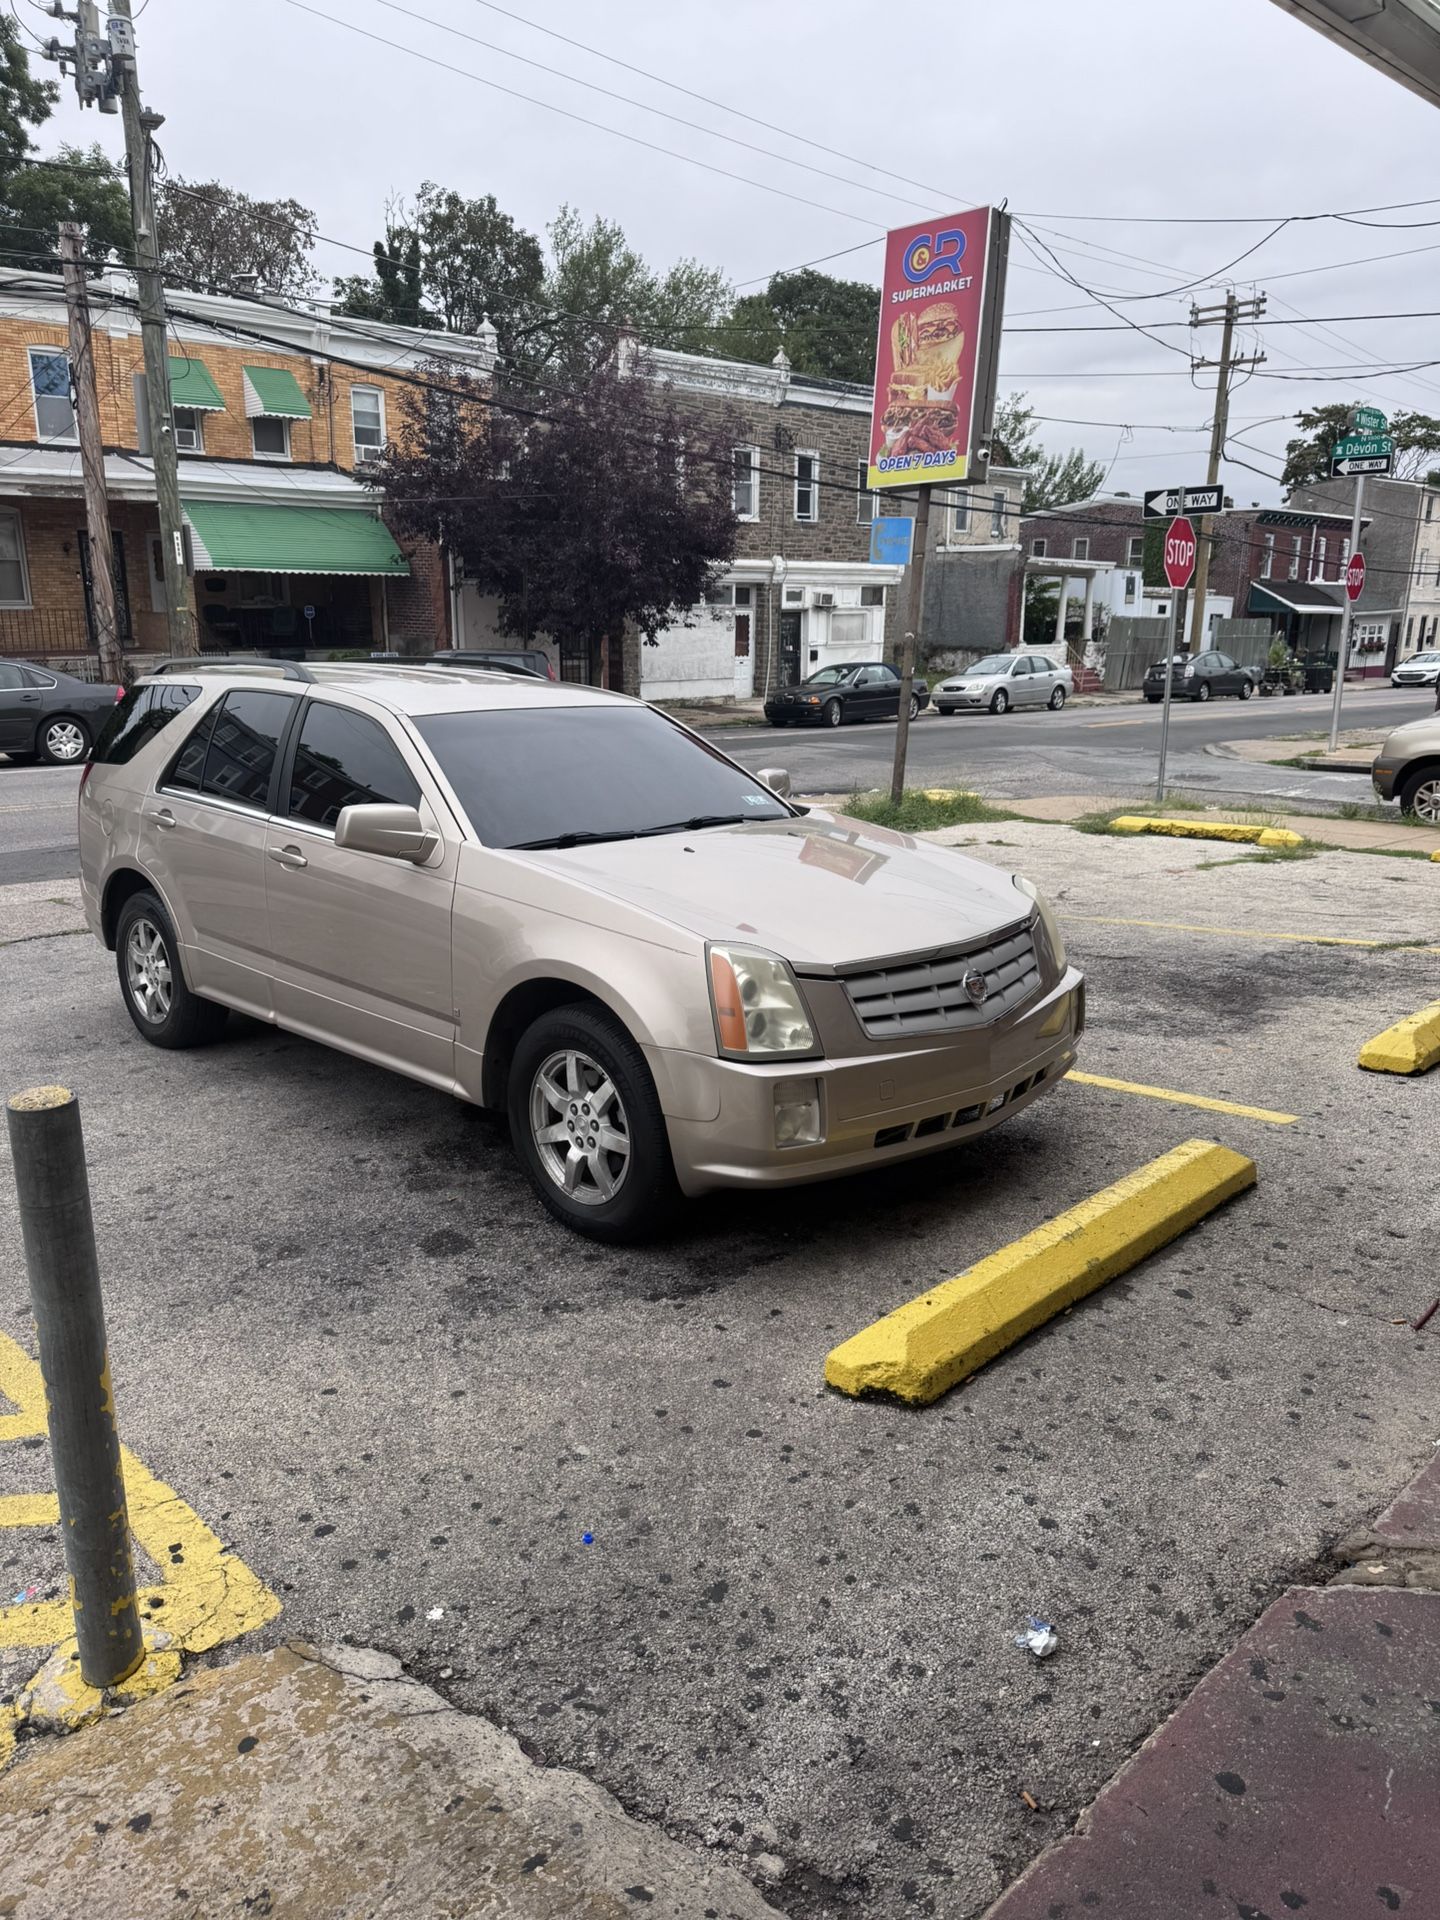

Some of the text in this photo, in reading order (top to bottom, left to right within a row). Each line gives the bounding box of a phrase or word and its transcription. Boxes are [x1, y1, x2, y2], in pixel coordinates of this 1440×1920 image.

[891, 275, 973, 304] SUPERMARKET
[1361, 412, 1379, 427] Wister
[1381, 441, 1391, 452] St
[879, 450, 957, 471] OPEN 7 DAYS
[1349, 460, 1383, 470] ONE WAY
[1166, 494, 1214, 508] ONE WAY
[1166, 538, 1194, 567] STOP
[1348, 568, 1364, 586] STOP
